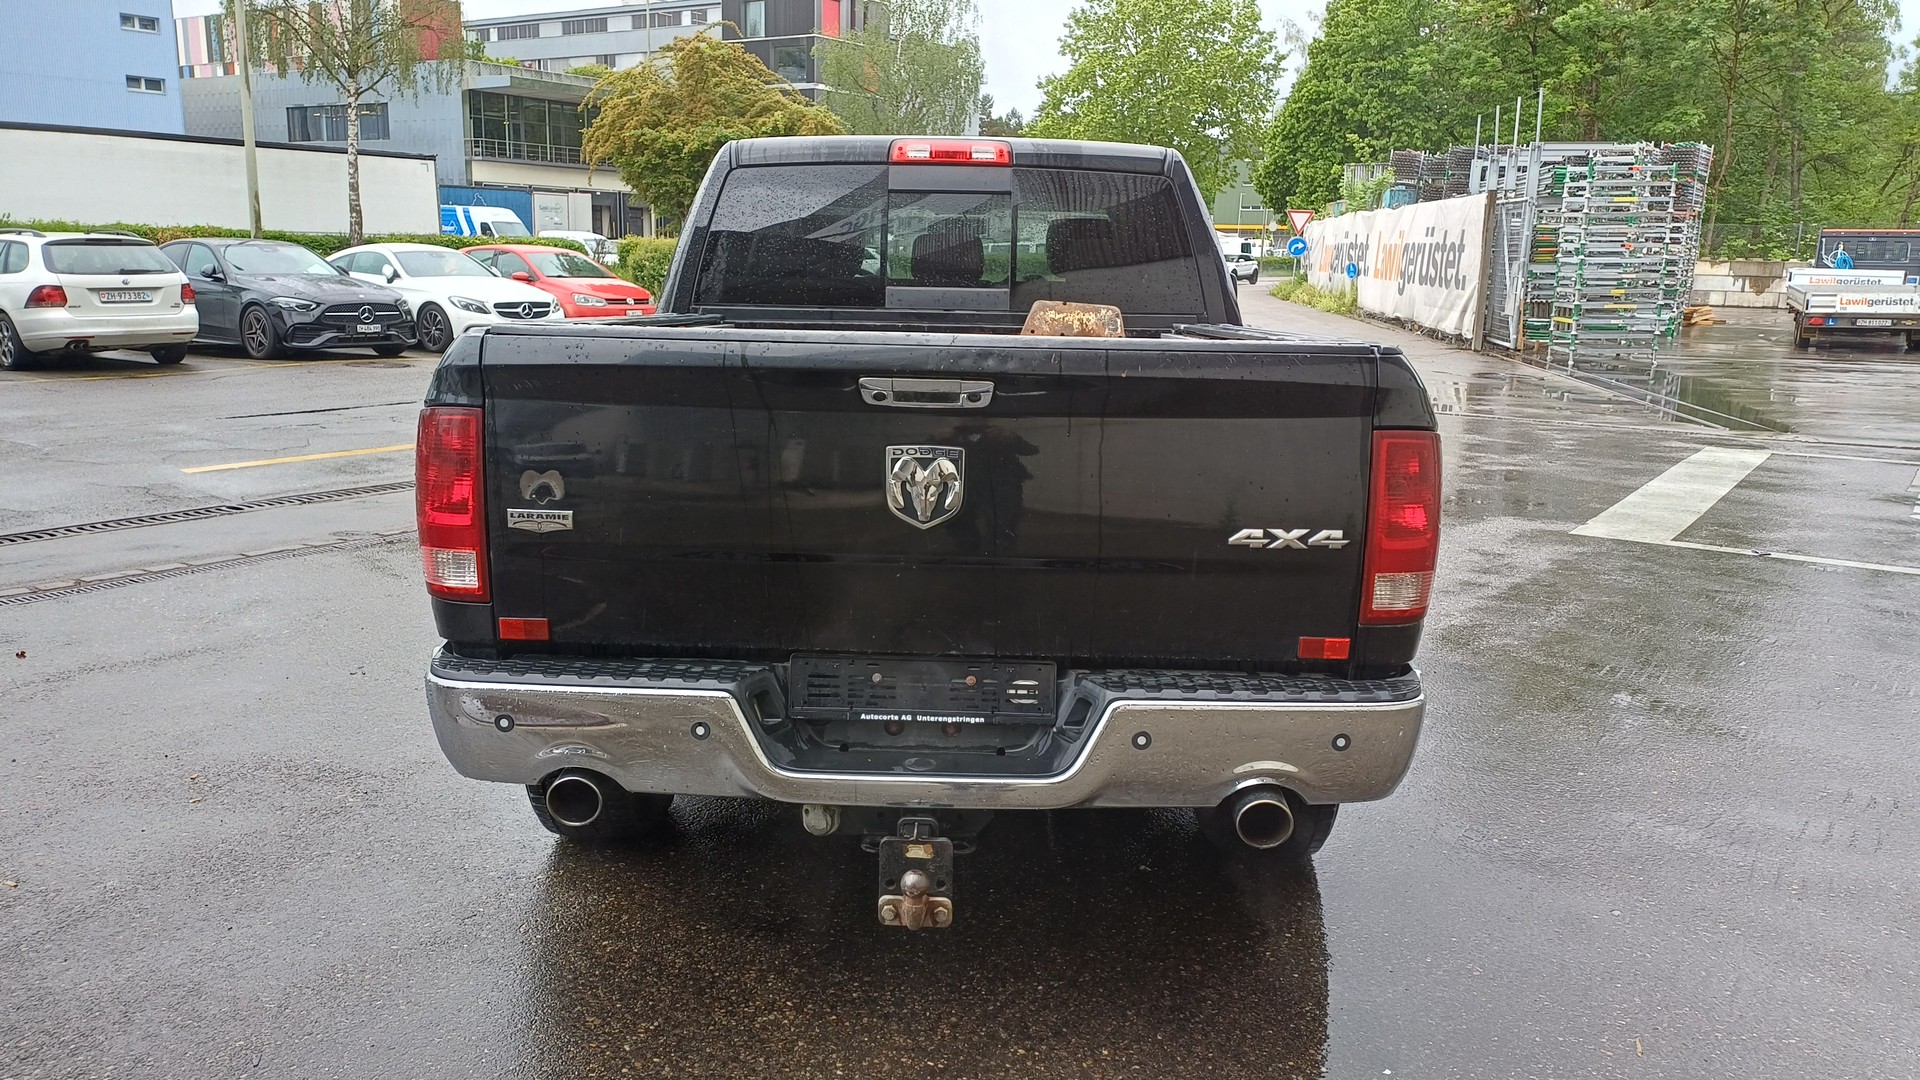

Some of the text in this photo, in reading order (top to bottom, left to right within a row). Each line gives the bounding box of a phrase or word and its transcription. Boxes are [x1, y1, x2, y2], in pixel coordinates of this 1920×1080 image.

[1373, 226, 1467, 296] Lawilgerüstet.
[893, 448, 960, 457] DODGE
[510, 512, 570, 521] LARAMIE
[1228, 528, 1350, 550] 4X4
[860, 713, 899, 721] Autocorte
[916, 715, 985, 724] Unterengstringen
